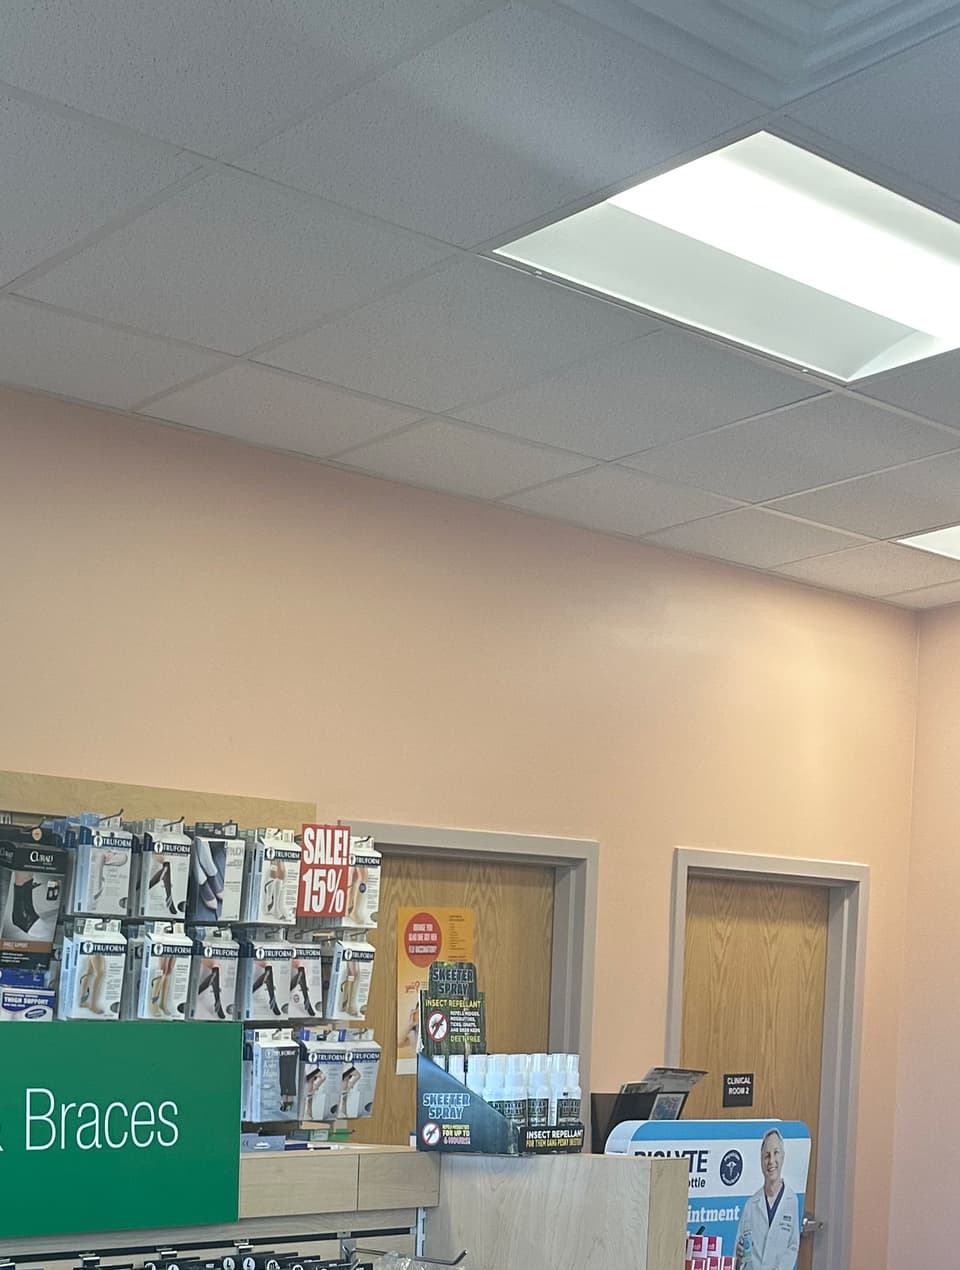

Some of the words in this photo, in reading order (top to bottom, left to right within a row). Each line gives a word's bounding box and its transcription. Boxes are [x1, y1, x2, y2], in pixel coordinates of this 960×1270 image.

[103, 838, 132, 847] TRUFORM
[303, 828, 350, 865] SALE!
[163, 844, 191, 853] TRUFORM
[30, 851, 54, 862] CURAD
[275, 849, 301, 859] TRUFORM
[355, 855, 381, 866] TRUFORM
[303, 869, 345, 914] 15%
[93, 944, 125, 952] TRUFORM
[163, 945, 191, 954] TRUFORM
[213, 948, 239, 958] TRUFORM
[264, 949, 294, 958] TRUFORM
[296, 948, 321, 959] TRUFORM
[352, 950, 375, 960] TRUFORM
[432, 968, 473, 982] SKEETER
[438, 982, 469, 995] SPRAY
[449, 1000, 481, 1008] REPELLANT
[318, 1053, 345, 1062] TRUFORM
[354, 1052, 380, 1061] TRUFORM
[727, 1077, 751, 1086] CLINICAL
[729, 1087, 744, 1095] ROOM
[423, 1093, 471, 1106] SKEETER
[429, 1107, 463, 1119] SPRAY
[24, 1087, 180, 1154] Braces
[527, 1130, 550, 1138] INSECT
[552, 1130, 583, 1138] REPELLANT
